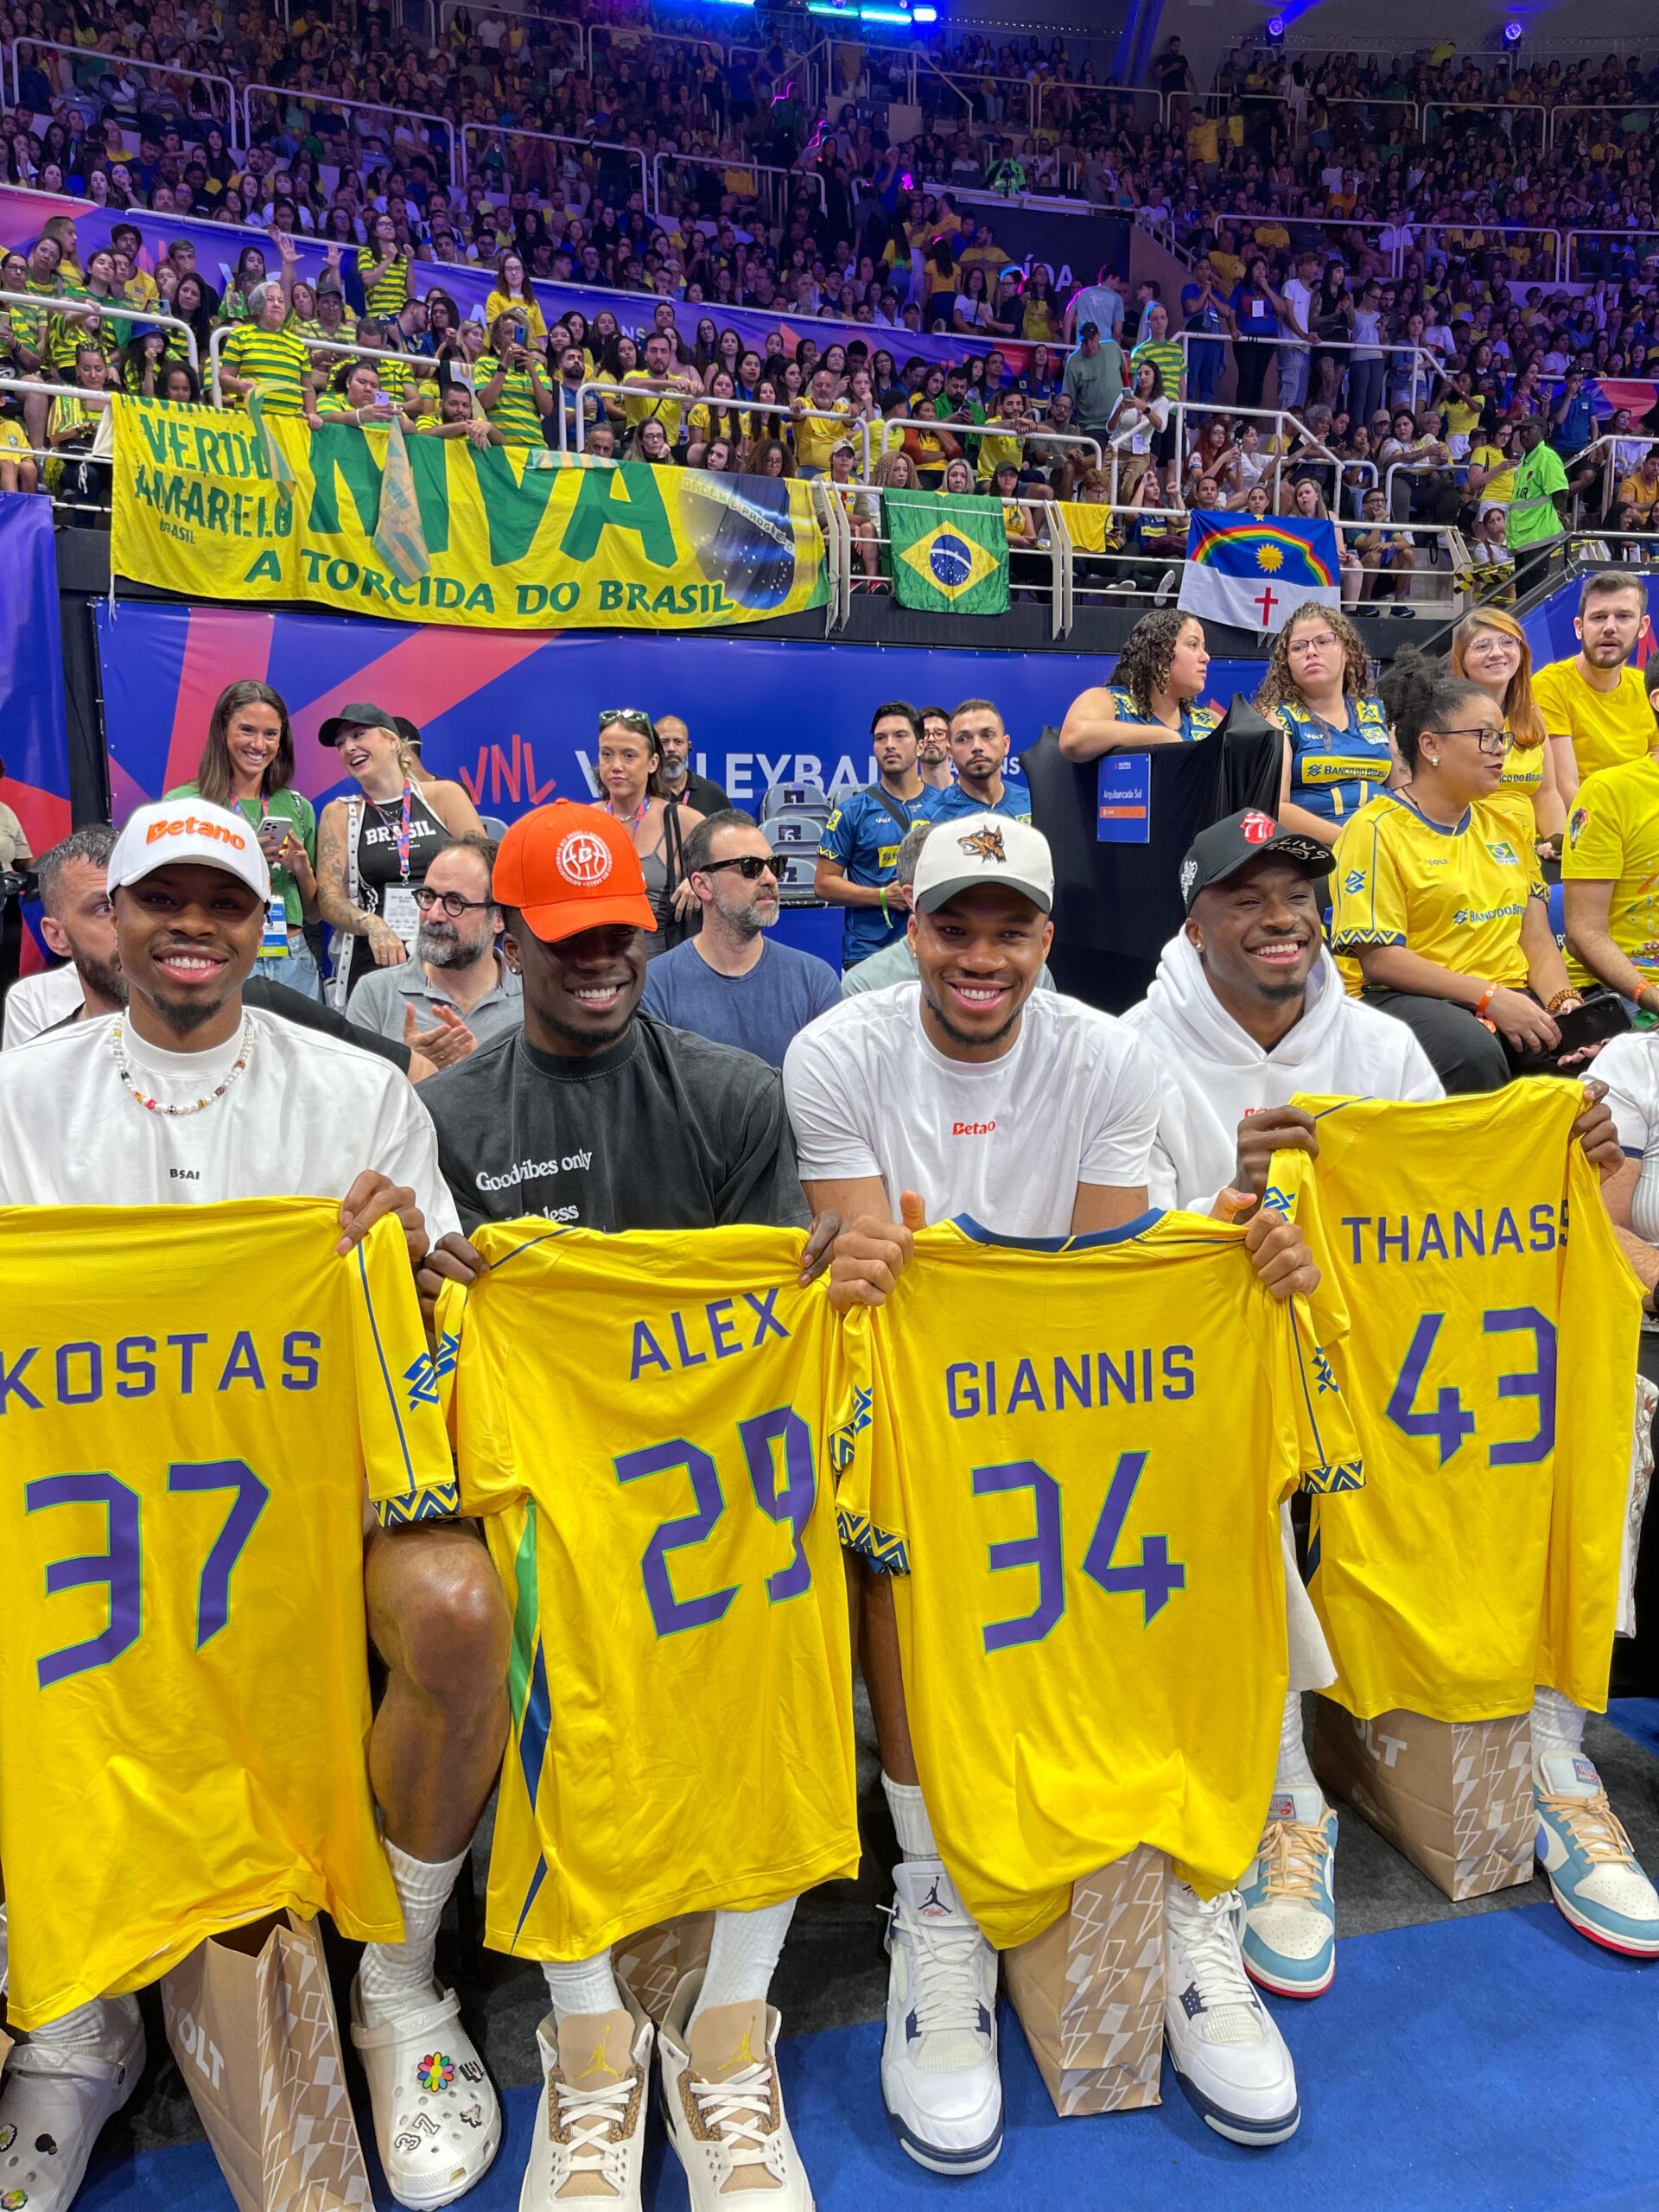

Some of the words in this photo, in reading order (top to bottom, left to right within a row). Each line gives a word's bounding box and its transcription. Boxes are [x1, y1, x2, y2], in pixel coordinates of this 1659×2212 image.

[1024, 254, 1073, 292] ÍDA
[135, 465, 293, 538] AMARELO
[159, 518, 196, 545] BRASIL
[244, 550, 282, 583] A
[300, 549, 495, 614] TORCIDA
[516, 582, 581, 615] DO
[598, 580, 734, 614] BRASIL
[459, 734, 556, 805] VNL
[1324, 766, 1353, 776] BANCO
[1354, 767, 1366, 777] DO
[145, 817, 245, 851] Betano
[365, 821, 436, 846] BRASIL
[169, 1168, 200, 1180] BSAI
[476, 1164, 522, 1191] Good
[562, 1148, 593, 1171] only
[629, 1287, 791, 1381] ALEX
[0, 1331, 321, 1414] KOSTAS
[945, 1344, 1195, 1420] GIANNIS
[1384, 1305, 1558, 1469] 43
[611, 1403, 819, 1641] 29
[970, 1449, 1187, 1657] 34
[23, 1458, 271, 1692] 37
[394, 2113, 441, 2152] 37
